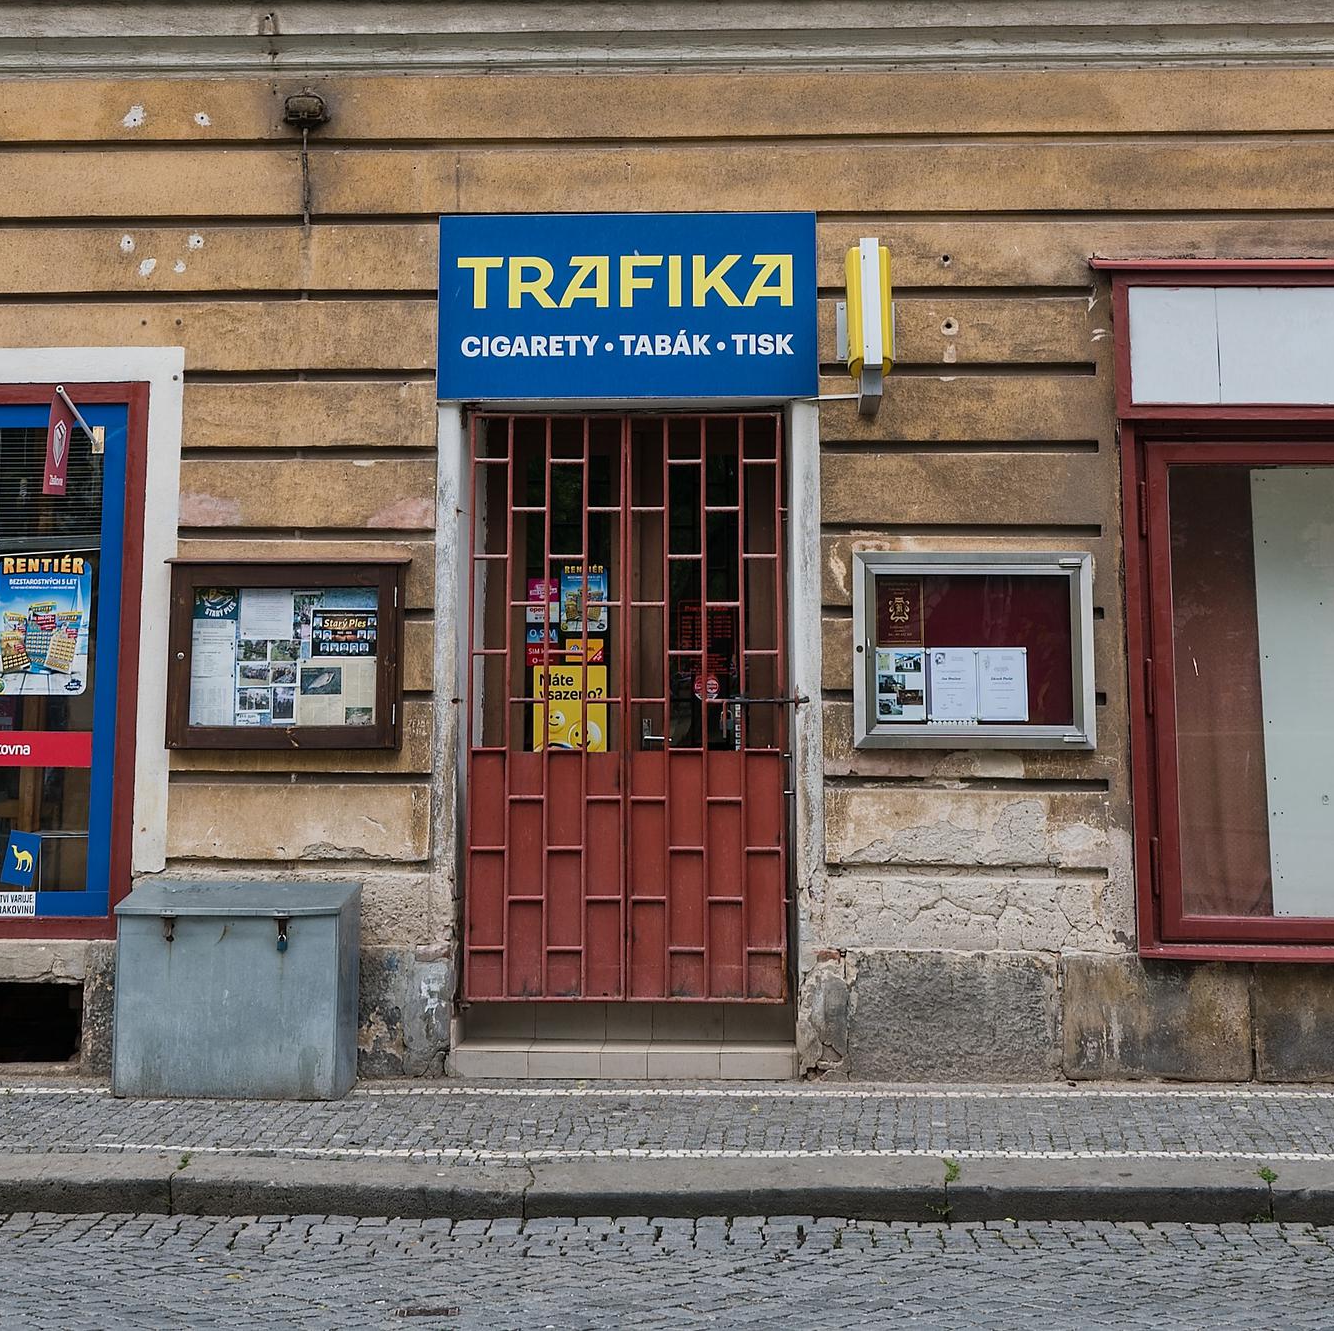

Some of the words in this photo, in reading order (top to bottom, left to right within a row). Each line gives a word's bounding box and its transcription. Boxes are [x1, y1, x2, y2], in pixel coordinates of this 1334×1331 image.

[457, 254, 794, 309] TRAFIKA
[461, 335, 599, 358] CIGARETY
[619, 329, 711, 356] TABÁK
[731, 333, 794, 355] TISK
[3, 554, 84, 574] RENTIÉR
[564, 564, 604, 574] RENIÉR
[9, 577, 60, 586] BEZSTAROSTNÝCH
[323, 617, 348, 629] Starý
[348, 617, 367, 628] Ples
[539, 629, 556, 638] SM
[539, 673, 574, 686] Máte
